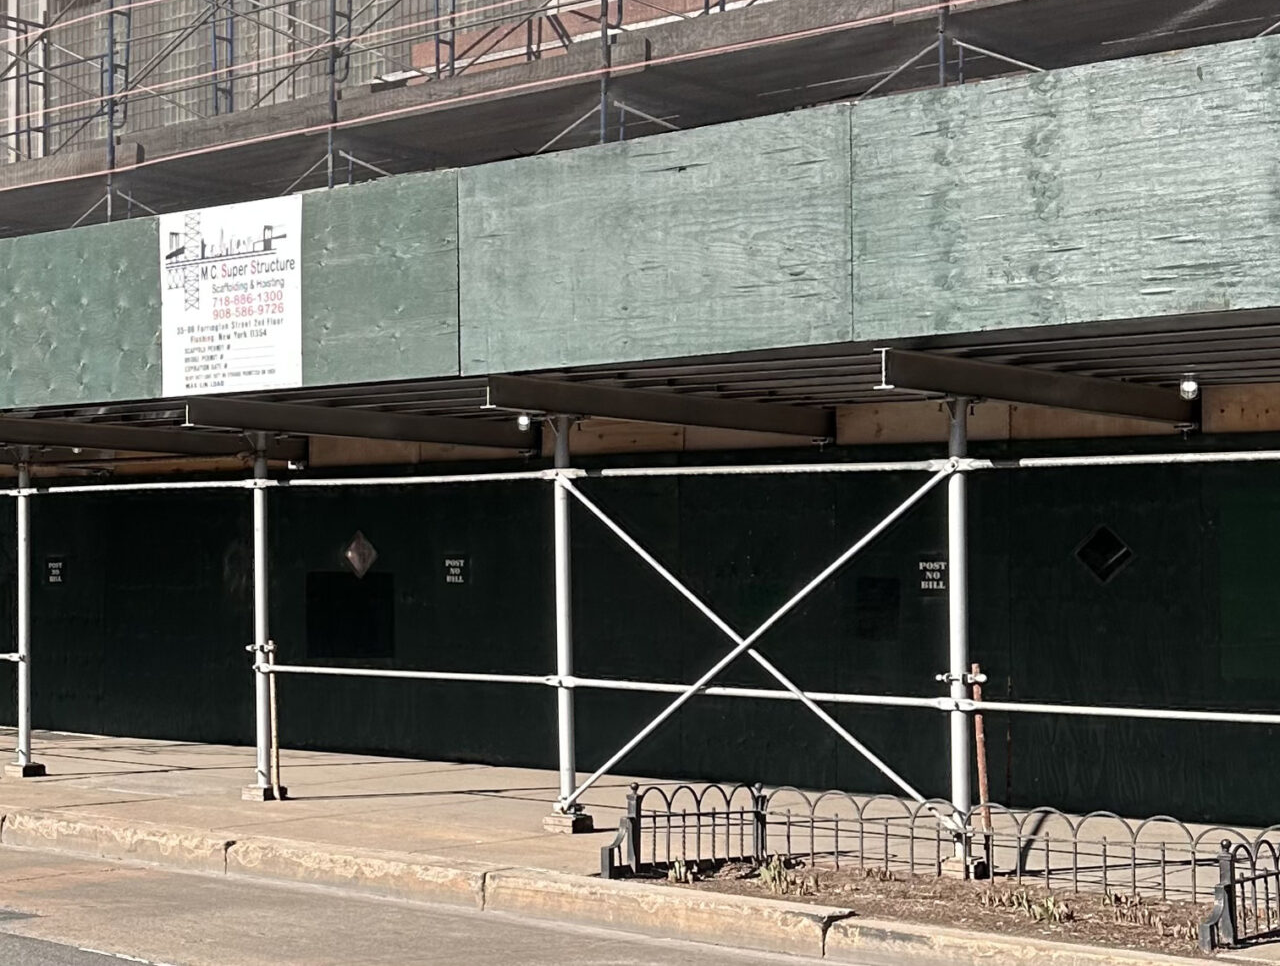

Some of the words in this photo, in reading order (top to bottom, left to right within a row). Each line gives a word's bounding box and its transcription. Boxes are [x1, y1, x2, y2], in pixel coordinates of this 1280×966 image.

[221, 263, 248, 279] Super
[250, 258, 296, 274] Structure
[250, 279, 255, 290] &
[213, 290, 283, 307] 718-886-1300
[213, 302, 284, 320] 908-586-9726
[218, 332, 231, 341] New
[234, 330, 247, 339] York
[445, 559, 464, 567] POST
[919, 561, 947, 570] POST
[450, 567, 461, 575] NO
[925, 571, 941, 580] NO
[446, 575, 464, 583] BILL
[921, 581, 946, 590] BILL
